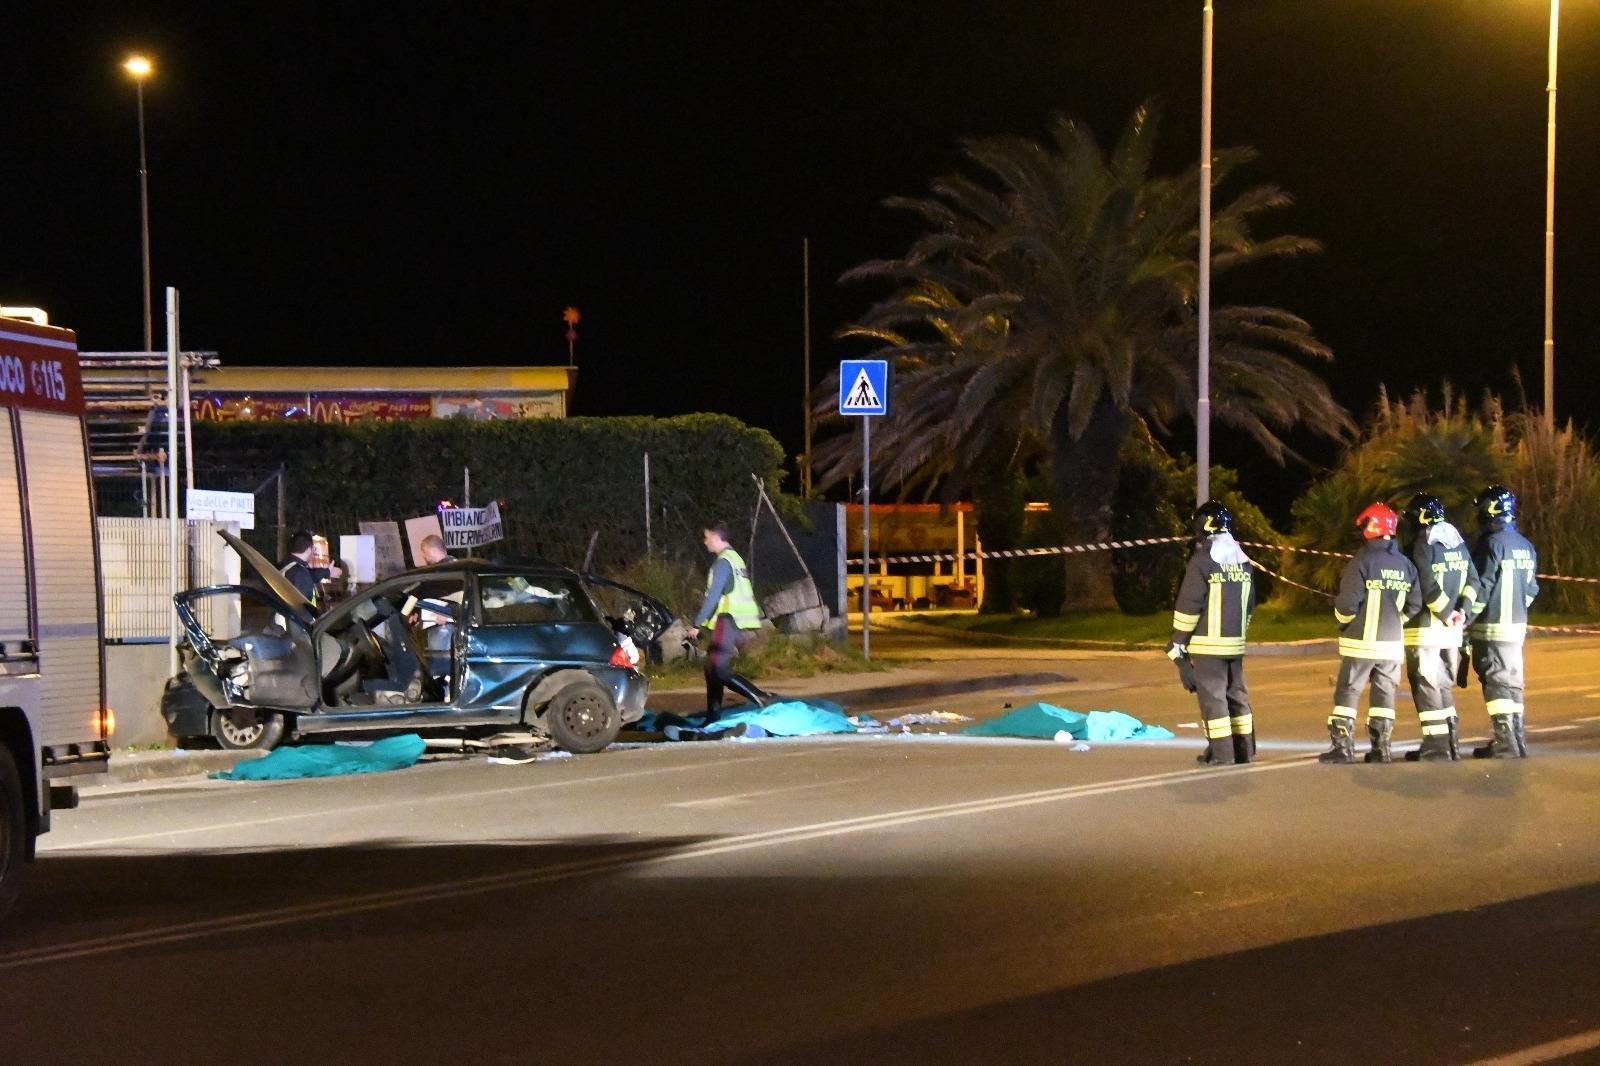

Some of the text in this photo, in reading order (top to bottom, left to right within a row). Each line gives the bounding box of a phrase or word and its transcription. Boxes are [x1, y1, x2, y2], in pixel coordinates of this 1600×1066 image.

[41, 359, 66, 401] 115
[1219, 562, 1244, 573] VIGILI
[1380, 568, 1405, 581] VIGILI
[1365, 579, 1386, 590] DEL
